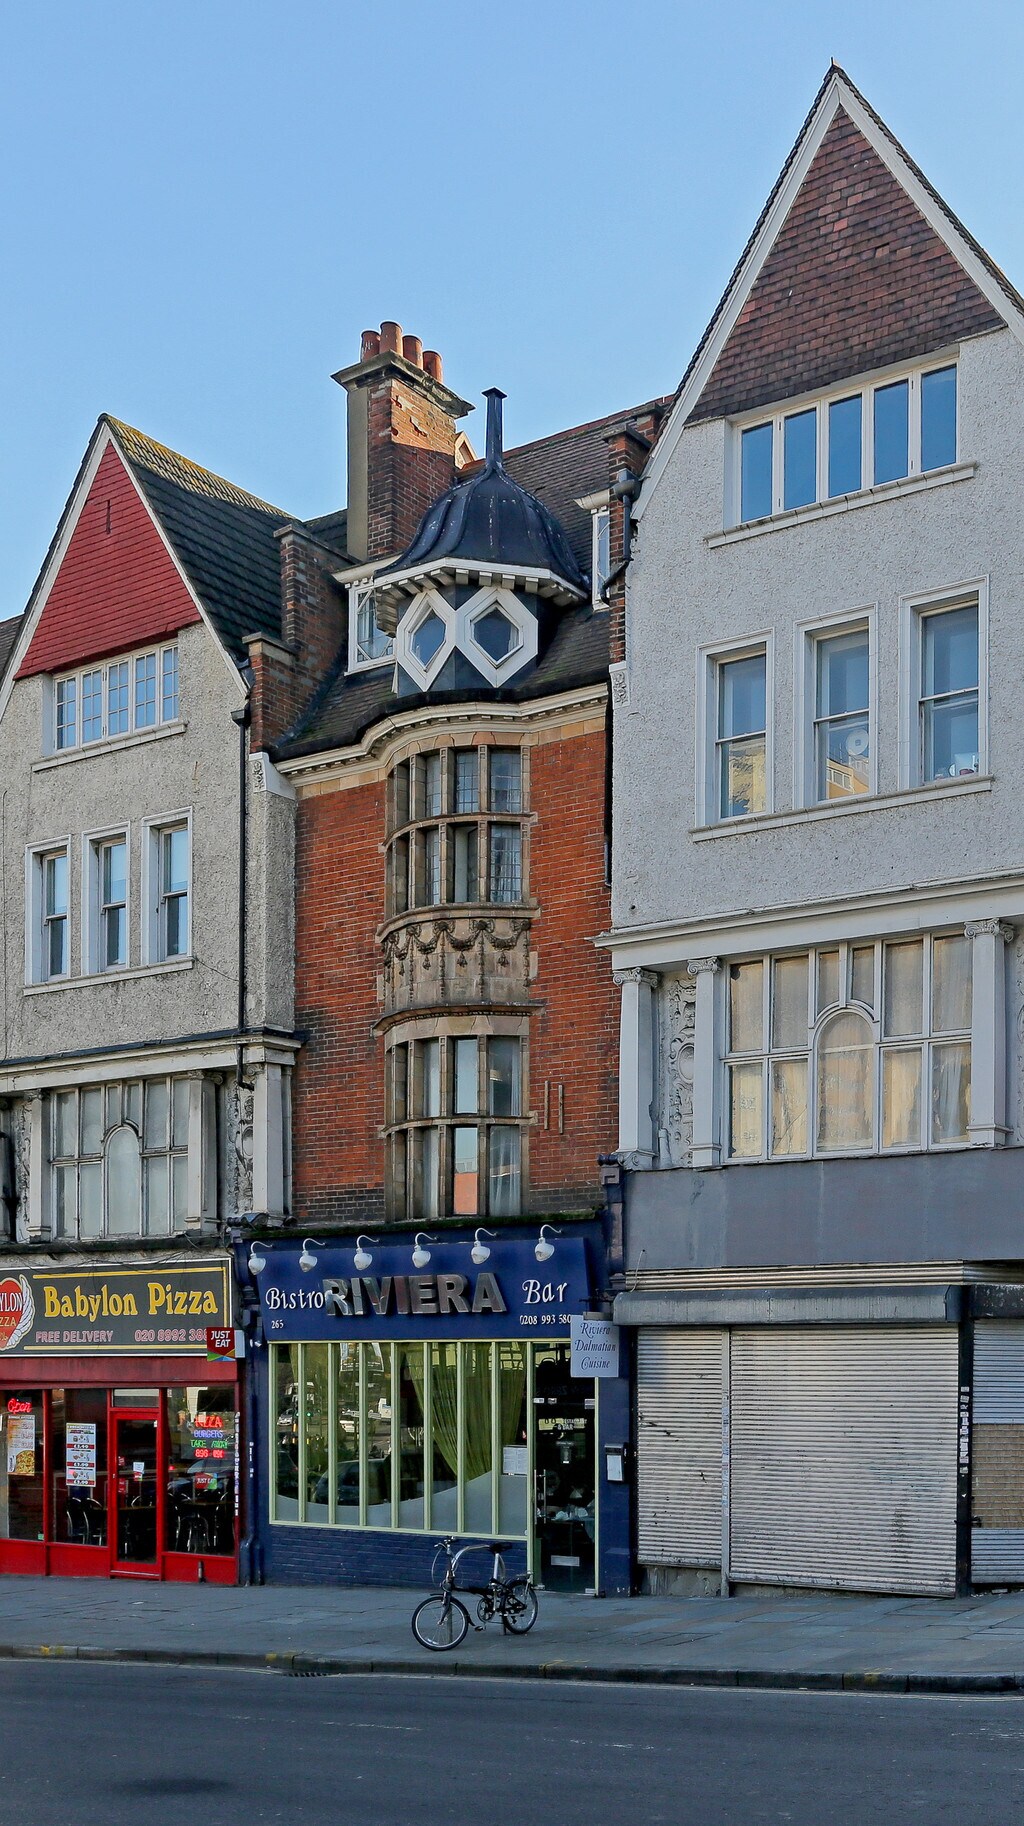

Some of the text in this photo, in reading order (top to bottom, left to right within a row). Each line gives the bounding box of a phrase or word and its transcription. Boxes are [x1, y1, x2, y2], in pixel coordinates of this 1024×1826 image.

[265, 1272, 568, 1317] Bistro RIVIERA Bar
[43, 1282, 218, 1322] Babylon Pizza
[271, 1320, 284, 1329] 265
[541, 1314, 556, 1325] 993
[134, 1329, 155, 1342] 020
[157, 1328, 186, 1342] 8992
[210, 1330, 231, 1340] JUST
[580, 1322, 611, 1338] Riviera
[36, 1330, 114, 1343] FREE DELIVERY
[215, 1339, 231, 1348] EAT
[574, 1340, 616, 1352] Dalmatian
[581, 1356, 610, 1370] Cuisine
[194, 1429, 224, 1439] BURGERS
